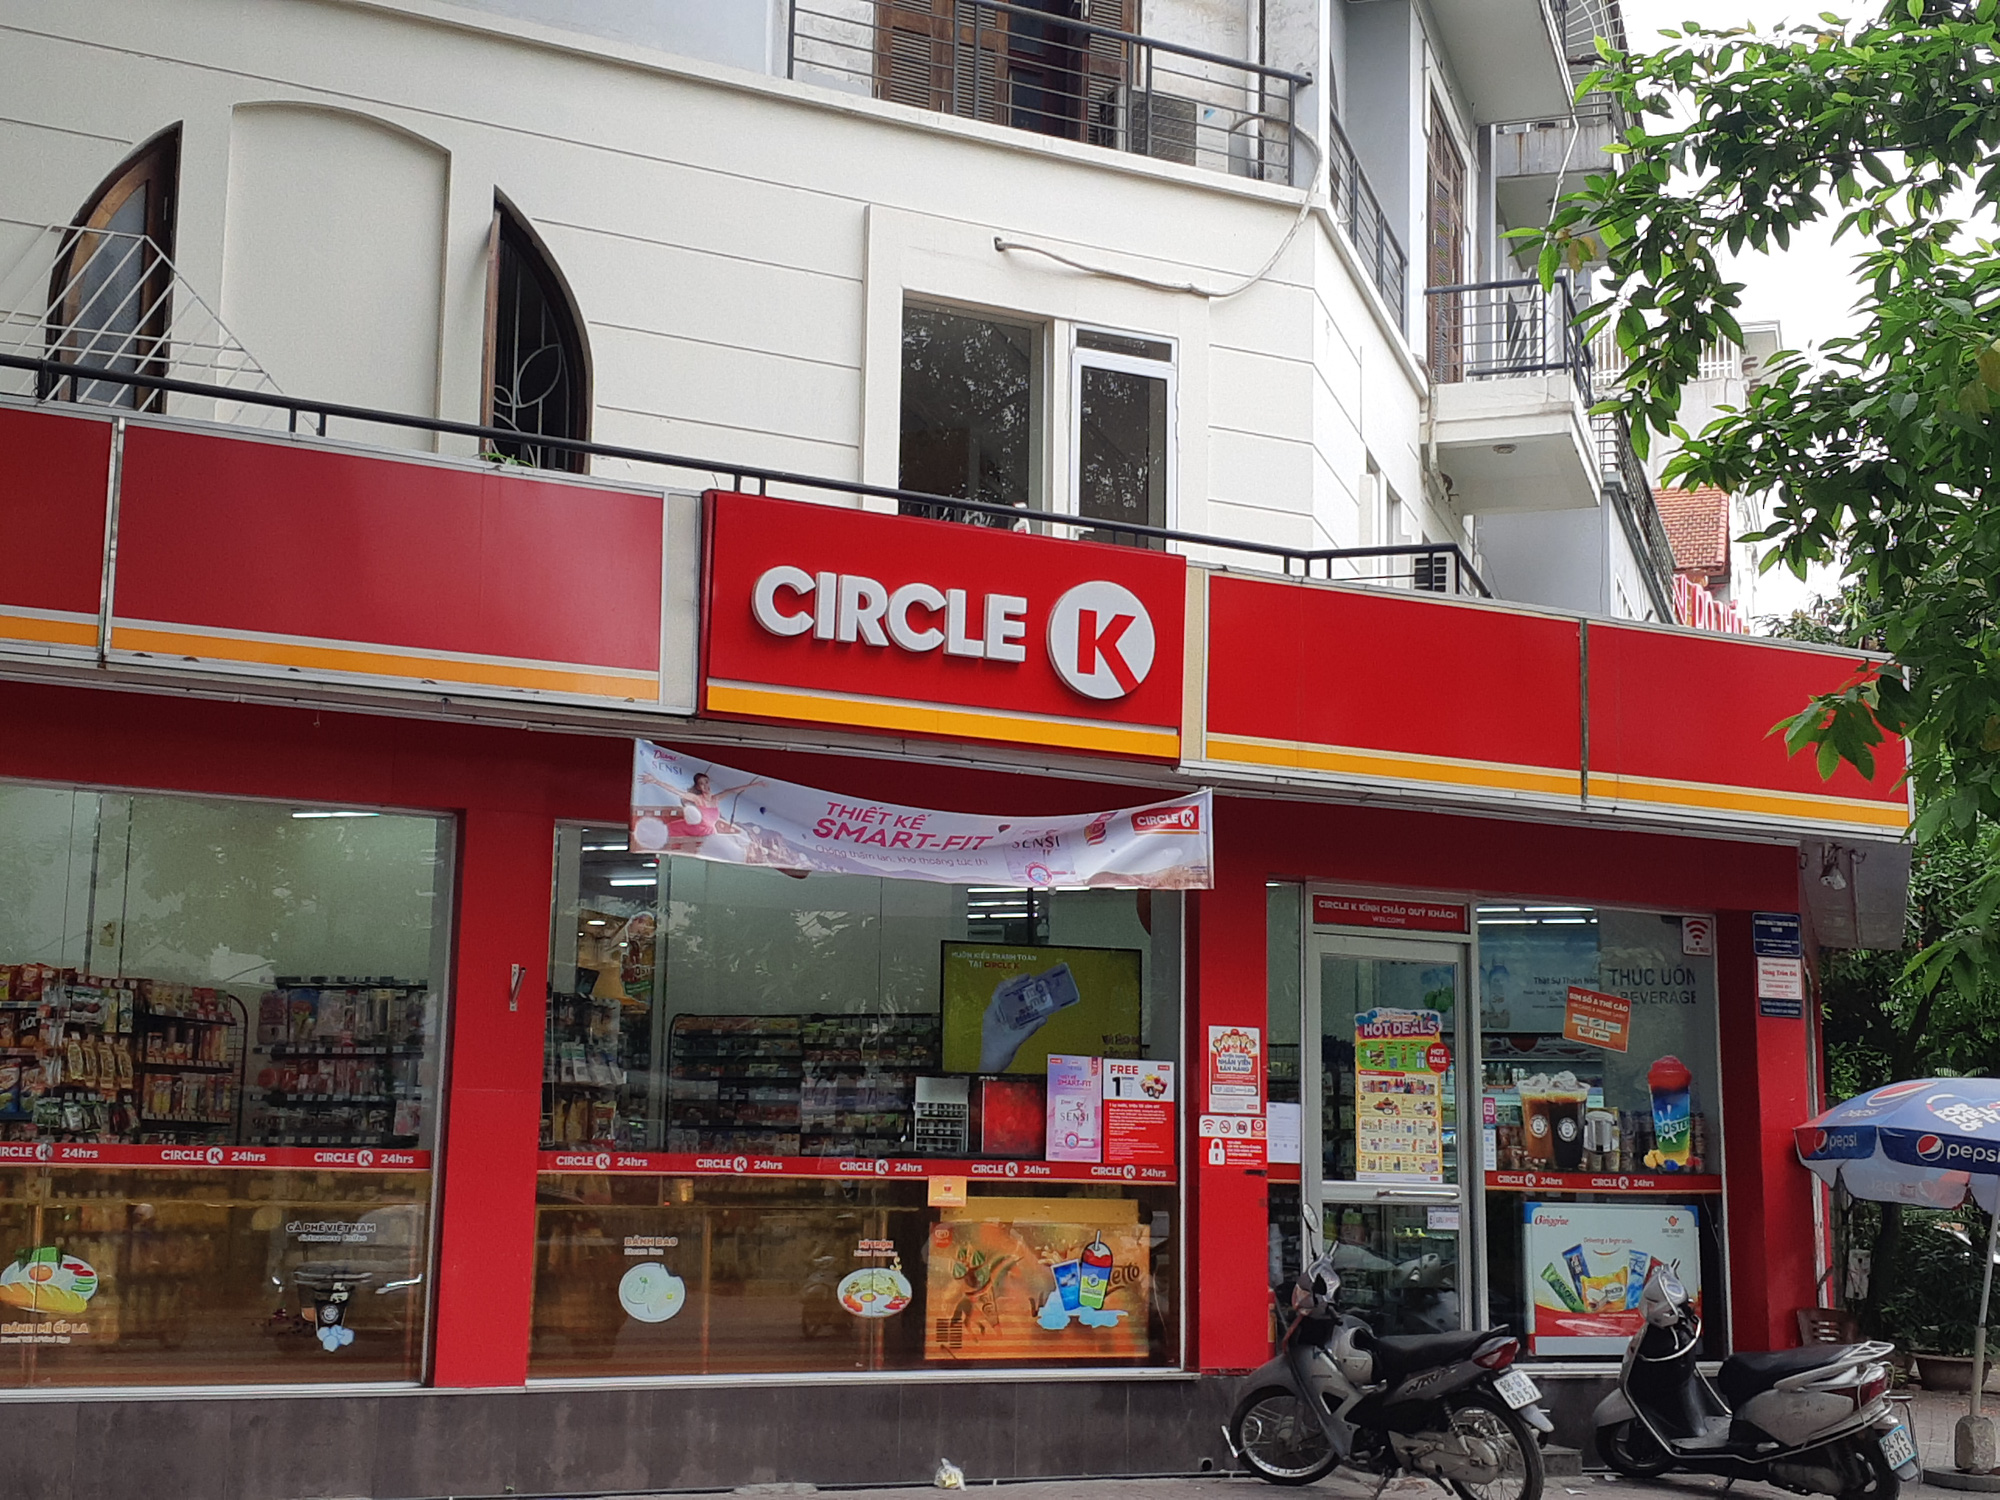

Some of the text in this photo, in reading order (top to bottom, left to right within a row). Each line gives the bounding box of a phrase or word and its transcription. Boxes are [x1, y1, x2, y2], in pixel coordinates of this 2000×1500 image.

[752, 565, 1144, 698] CIRCLE K
[827, 801, 932, 831] THIẾT KẾ
[1136, 814, 1179, 827] CIRCLE
[812, 818, 994, 851] SMART-FIT
[1318, 900, 1350, 911] CIRCLE
[1607, 965, 1655, 987] THÚC
[1364, 1019, 1437, 1036] HOT DEALS
[1430, 1048, 1445, 1056] HOT
[1429, 1056, 1447, 1064] SALE
[1110, 1064, 1140, 1075] FREE
[1112, 1076, 1121, 1097] 1
[1060, 1112, 1090, 1122] SENSI
[1829, 1132, 1858, 1150] pepsi
[61, 1148, 98, 1159] 24hrs
[160, 1150, 204, 1161] CIRCLE
[231, 1151, 266, 1163] 24hrs
[314, 1152, 355, 1164] CIRCLE
[380, 1153, 413, 1165] 24hrs
[556, 1155, 594, 1167] CIRCLE
[616, 1156, 648, 1167] 24hrs
[695, 1158, 732, 1169] CIRCLE
[753, 1160, 783, 1170] 24hrs
[839, 1161, 874, 1172] CIRCLE
[894, 1162, 923, 1173] 24hrs
[971, 1164, 1004, 1175] CIRCLE
[1023, 1165, 1050, 1175] 24hrs
[1091, 1166, 1122, 1177] CIRCLE
[1141, 1168, 1166, 1178] 24hrs
[1497, 1174, 1524, 1184] CIRCLE
[1540, 1176, 1563, 1186] 24hrs
[1591, 1177, 1617, 1188] CIRCLE
[1633, 1179, 1655, 1188] 24hrs
[303, 1221, 326, 1232] PHÊ
[326, 1221, 351, 1234] VIỆT
[351, 1222, 377, 1232] NAM
[624, 1234, 655, 1247] BÁNH
[1888, 1443, 1912, 1466] 5815
